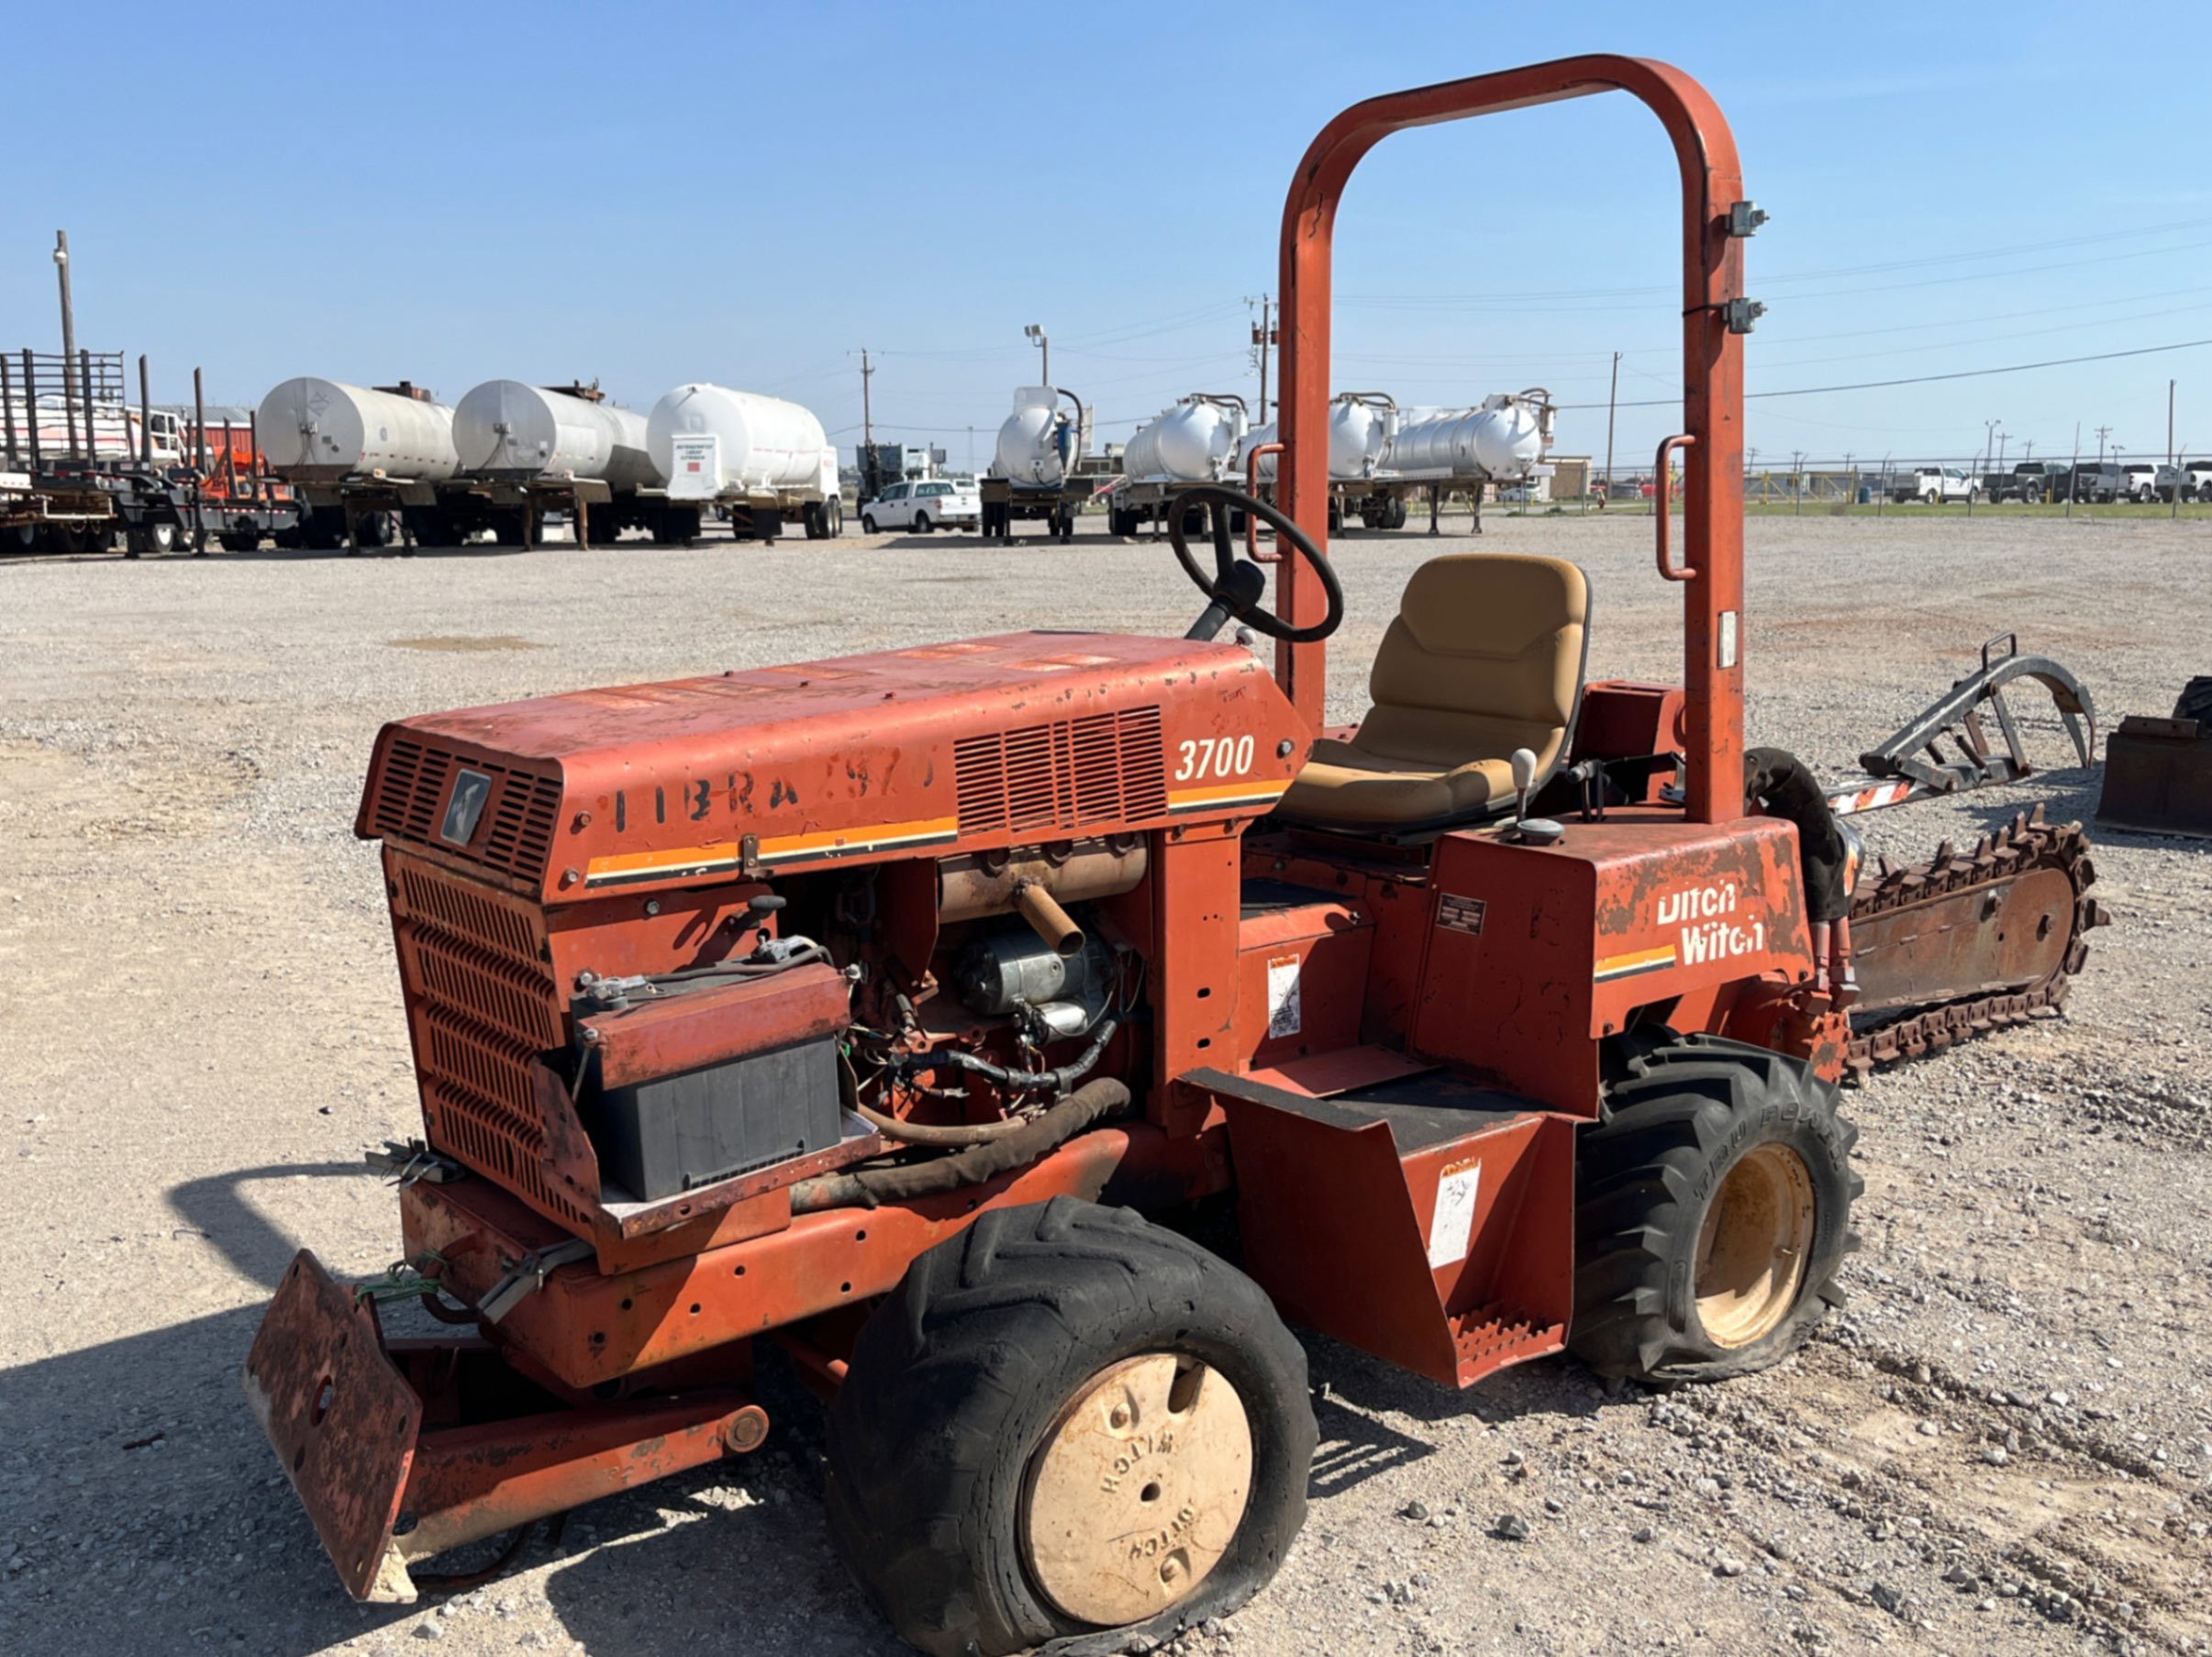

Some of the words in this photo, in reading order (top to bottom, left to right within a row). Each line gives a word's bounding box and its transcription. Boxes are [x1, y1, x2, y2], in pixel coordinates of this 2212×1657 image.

[1174, 734, 1255, 782] 3700
[1657, 879, 1737, 926] Ditch
[1681, 913, 1764, 966] Witch
[1692, 1119, 1747, 1201] TRU
[1099, 1431, 1174, 1495] WITCH
[1128, 1505, 1195, 1562] DITCH
